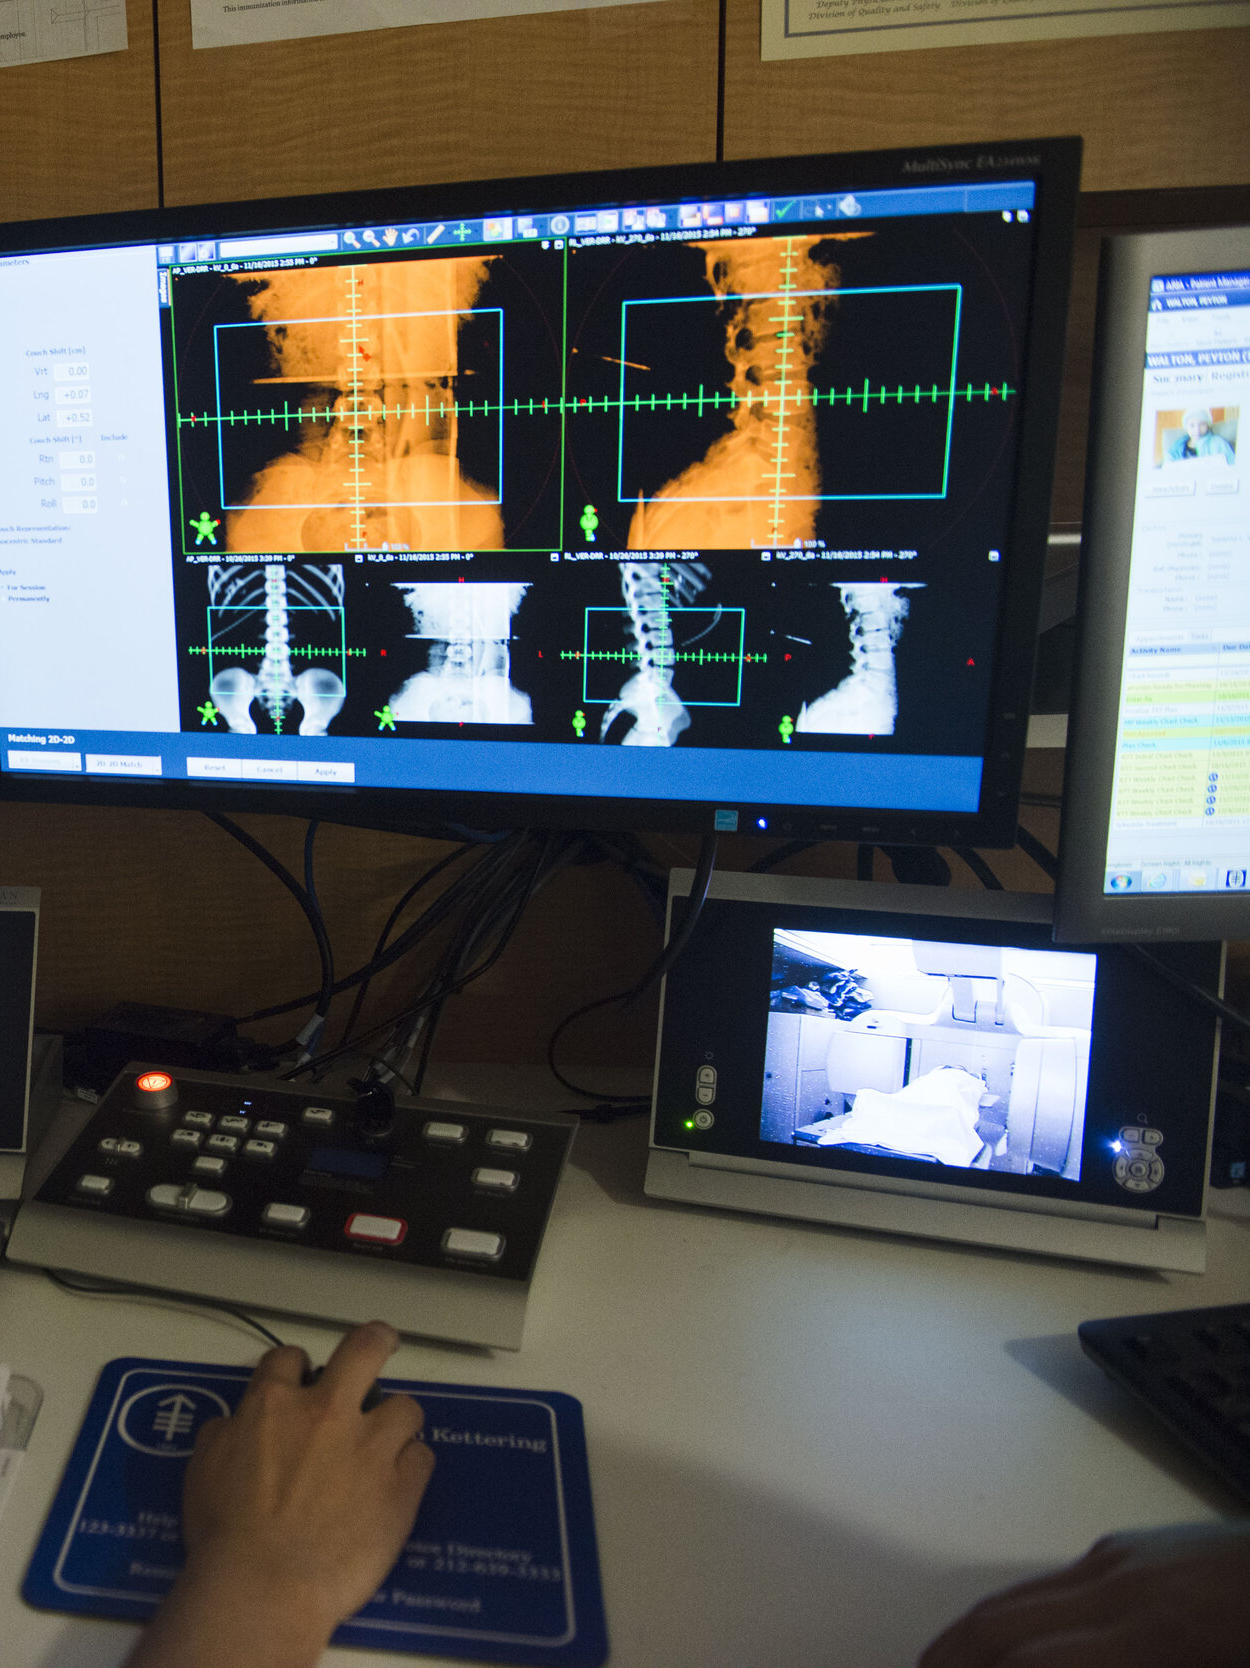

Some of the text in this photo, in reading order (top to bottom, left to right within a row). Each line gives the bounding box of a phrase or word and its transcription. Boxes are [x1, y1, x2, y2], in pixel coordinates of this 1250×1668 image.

[808, 10, 845, 20] Division
[846, 9, 856, 18] of
[857, 6, 891, 17] Quality
[892, 4, 910, 13] and
[911, 2, 941, 13] Safety
[1197, 350, 1241, 364] PEYTON
[34, 366, 88, 377] Vrt 0.00
[33, 389, 89, 401] Lng +0.07
[37, 412, 91, 423] Lat +0.52
[38, 454, 94, 464] Rtn 0.0
[33, 476, 95, 487] Pitch 0.0
[40, 499, 96, 509] Roll 0.0
[379, 649, 388, 657] R
[1130, 646, 1159, 656] Activity
[1159, 646, 1182, 654] Name
[7, 732, 76, 747] Matching 2D-2D
[314, 767, 337, 779] Apply
[432, 1428, 548, 1453] Kettering
